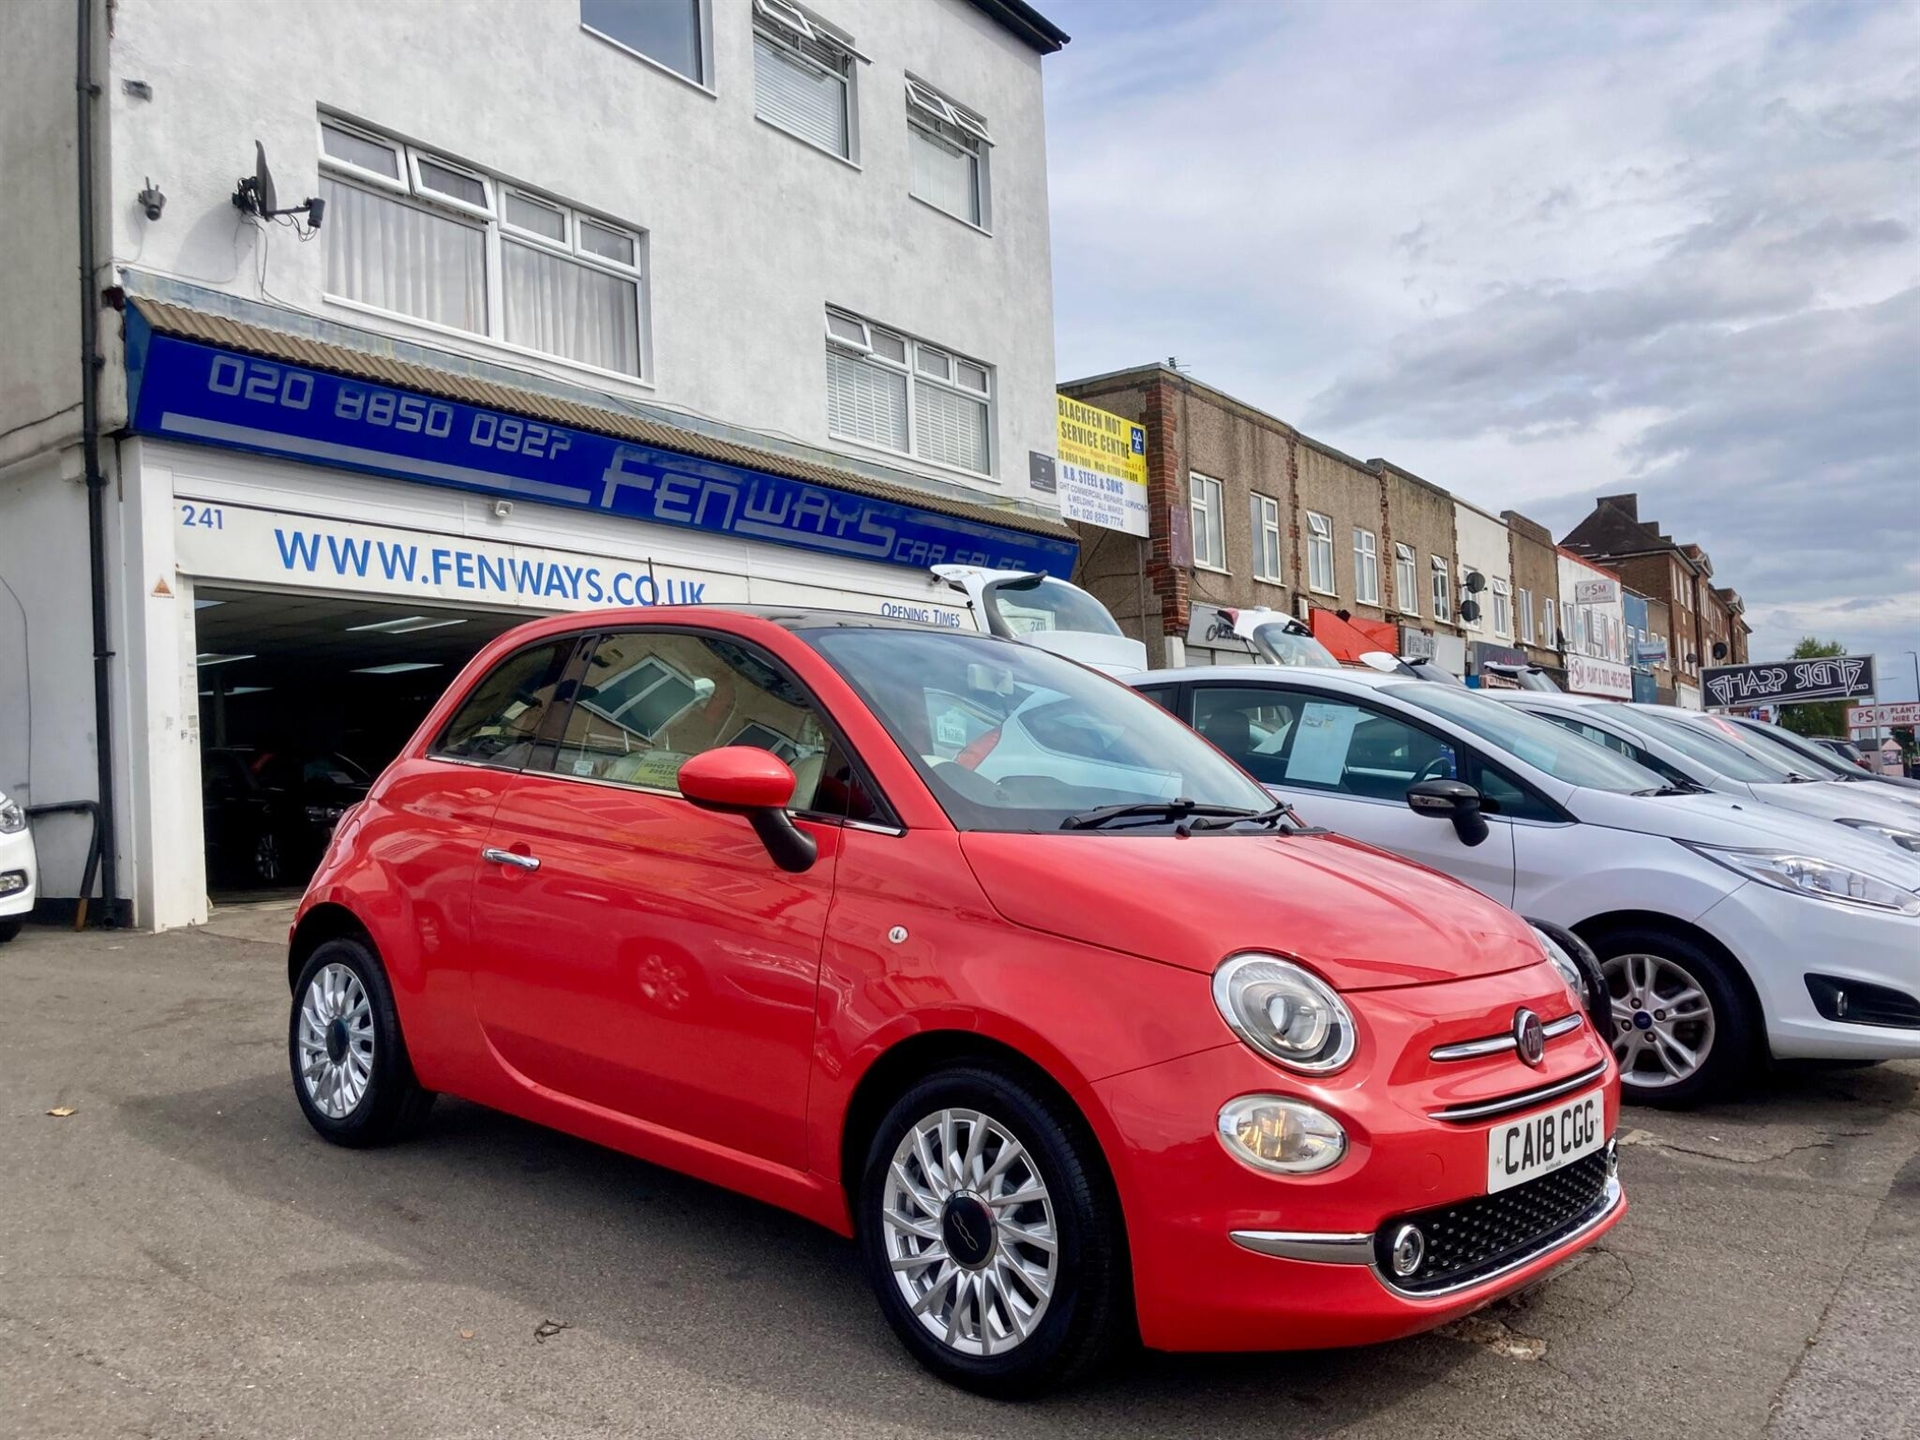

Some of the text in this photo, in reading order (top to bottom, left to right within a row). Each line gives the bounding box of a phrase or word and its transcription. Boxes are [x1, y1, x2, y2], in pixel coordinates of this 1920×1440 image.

[208, 354, 572, 460] 020 8850 0927
[1058, 398, 1122, 436] BLACKFEN MOT
[1061, 421, 1098, 449] SERVICE
[1100, 435, 1130, 459] CENTRE
[1070, 484, 1103, 501] COMMERCIAL
[1078, 470, 1098, 488] STEEL
[1100, 478, 1105, 490] &
[1106, 478, 1124, 495] SONS
[1072, 495, 1095, 508] WELDING
[181, 504, 224, 530] 241
[1069, 504, 1081, 516] Tel:
[1082, 508, 1094, 521] 020
[1109, 515, 1124, 527] 7774
[893, 537, 948, 565] CAR
[274, 528, 706, 606] WWW.FENWAYS.CO.UK
[1584, 583, 1607, 595] PSM
[881, 602, 960, 628] OPENING TIMES
[1707, 667, 1788, 706] SHARP
[1890, 706, 1916, 715] PLANT
[1892, 713, 1911, 723] HIRE
[1505, 1099, 1594, 1175] CA18 CGG
